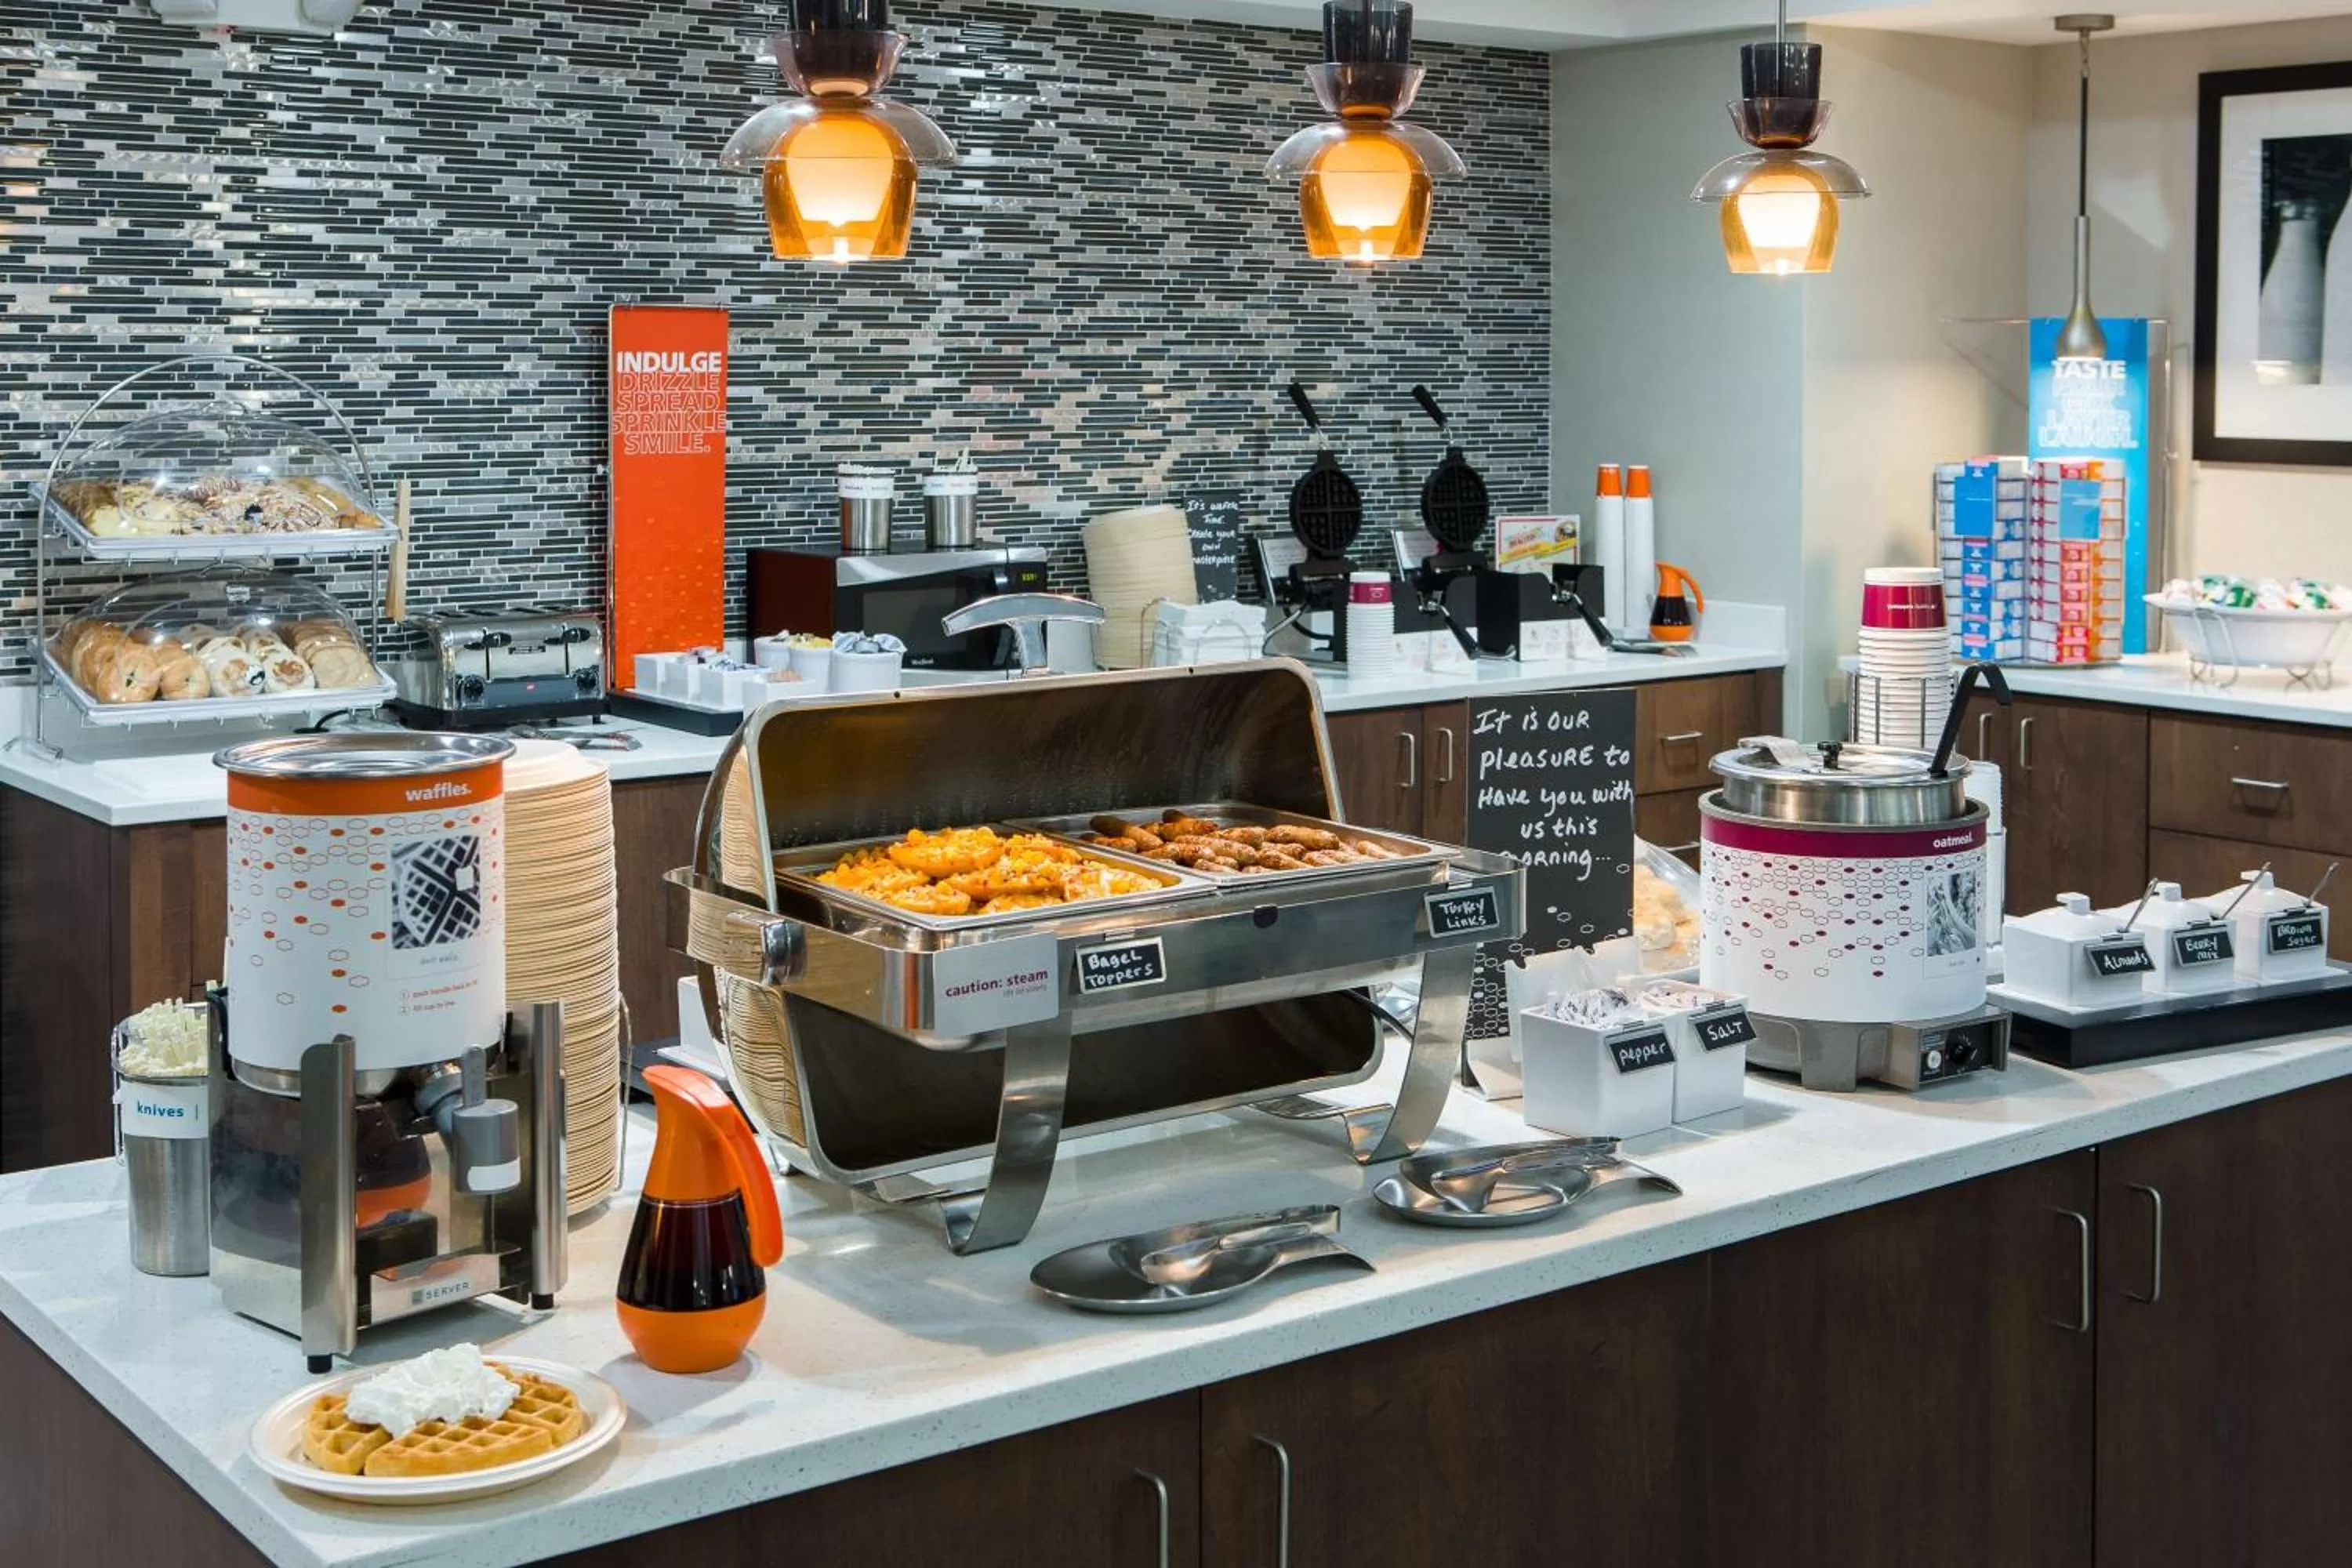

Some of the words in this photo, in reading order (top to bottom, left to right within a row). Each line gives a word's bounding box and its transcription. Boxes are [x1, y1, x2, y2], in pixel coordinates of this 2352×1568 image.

[617, 351, 722, 372] INDULGE
[2052, 360, 2126, 378] TASTE
[619, 372, 720, 392] DRIZZLE
[617, 391, 720, 412] SPREAD
[612, 411, 726, 434] SPRINKLE
[624, 432, 711, 455] SMILE.
[1472, 708, 1512, 734] It
[1523, 706, 1538, 731] is
[1603, 745, 1630, 766] to
[1478, 787, 1530, 809] Have
[1541, 787, 1586, 818] you
[1592, 779, 1635, 804] with
[1520, 821, 1544, 839] us
[1552, 816, 1599, 837] this
[946, 978, 1003, 997] caution:
[1007, 970, 1048, 986] steam
[136, 1101, 185, 1117] knives
[426, 1281, 470, 1300] SERVER
